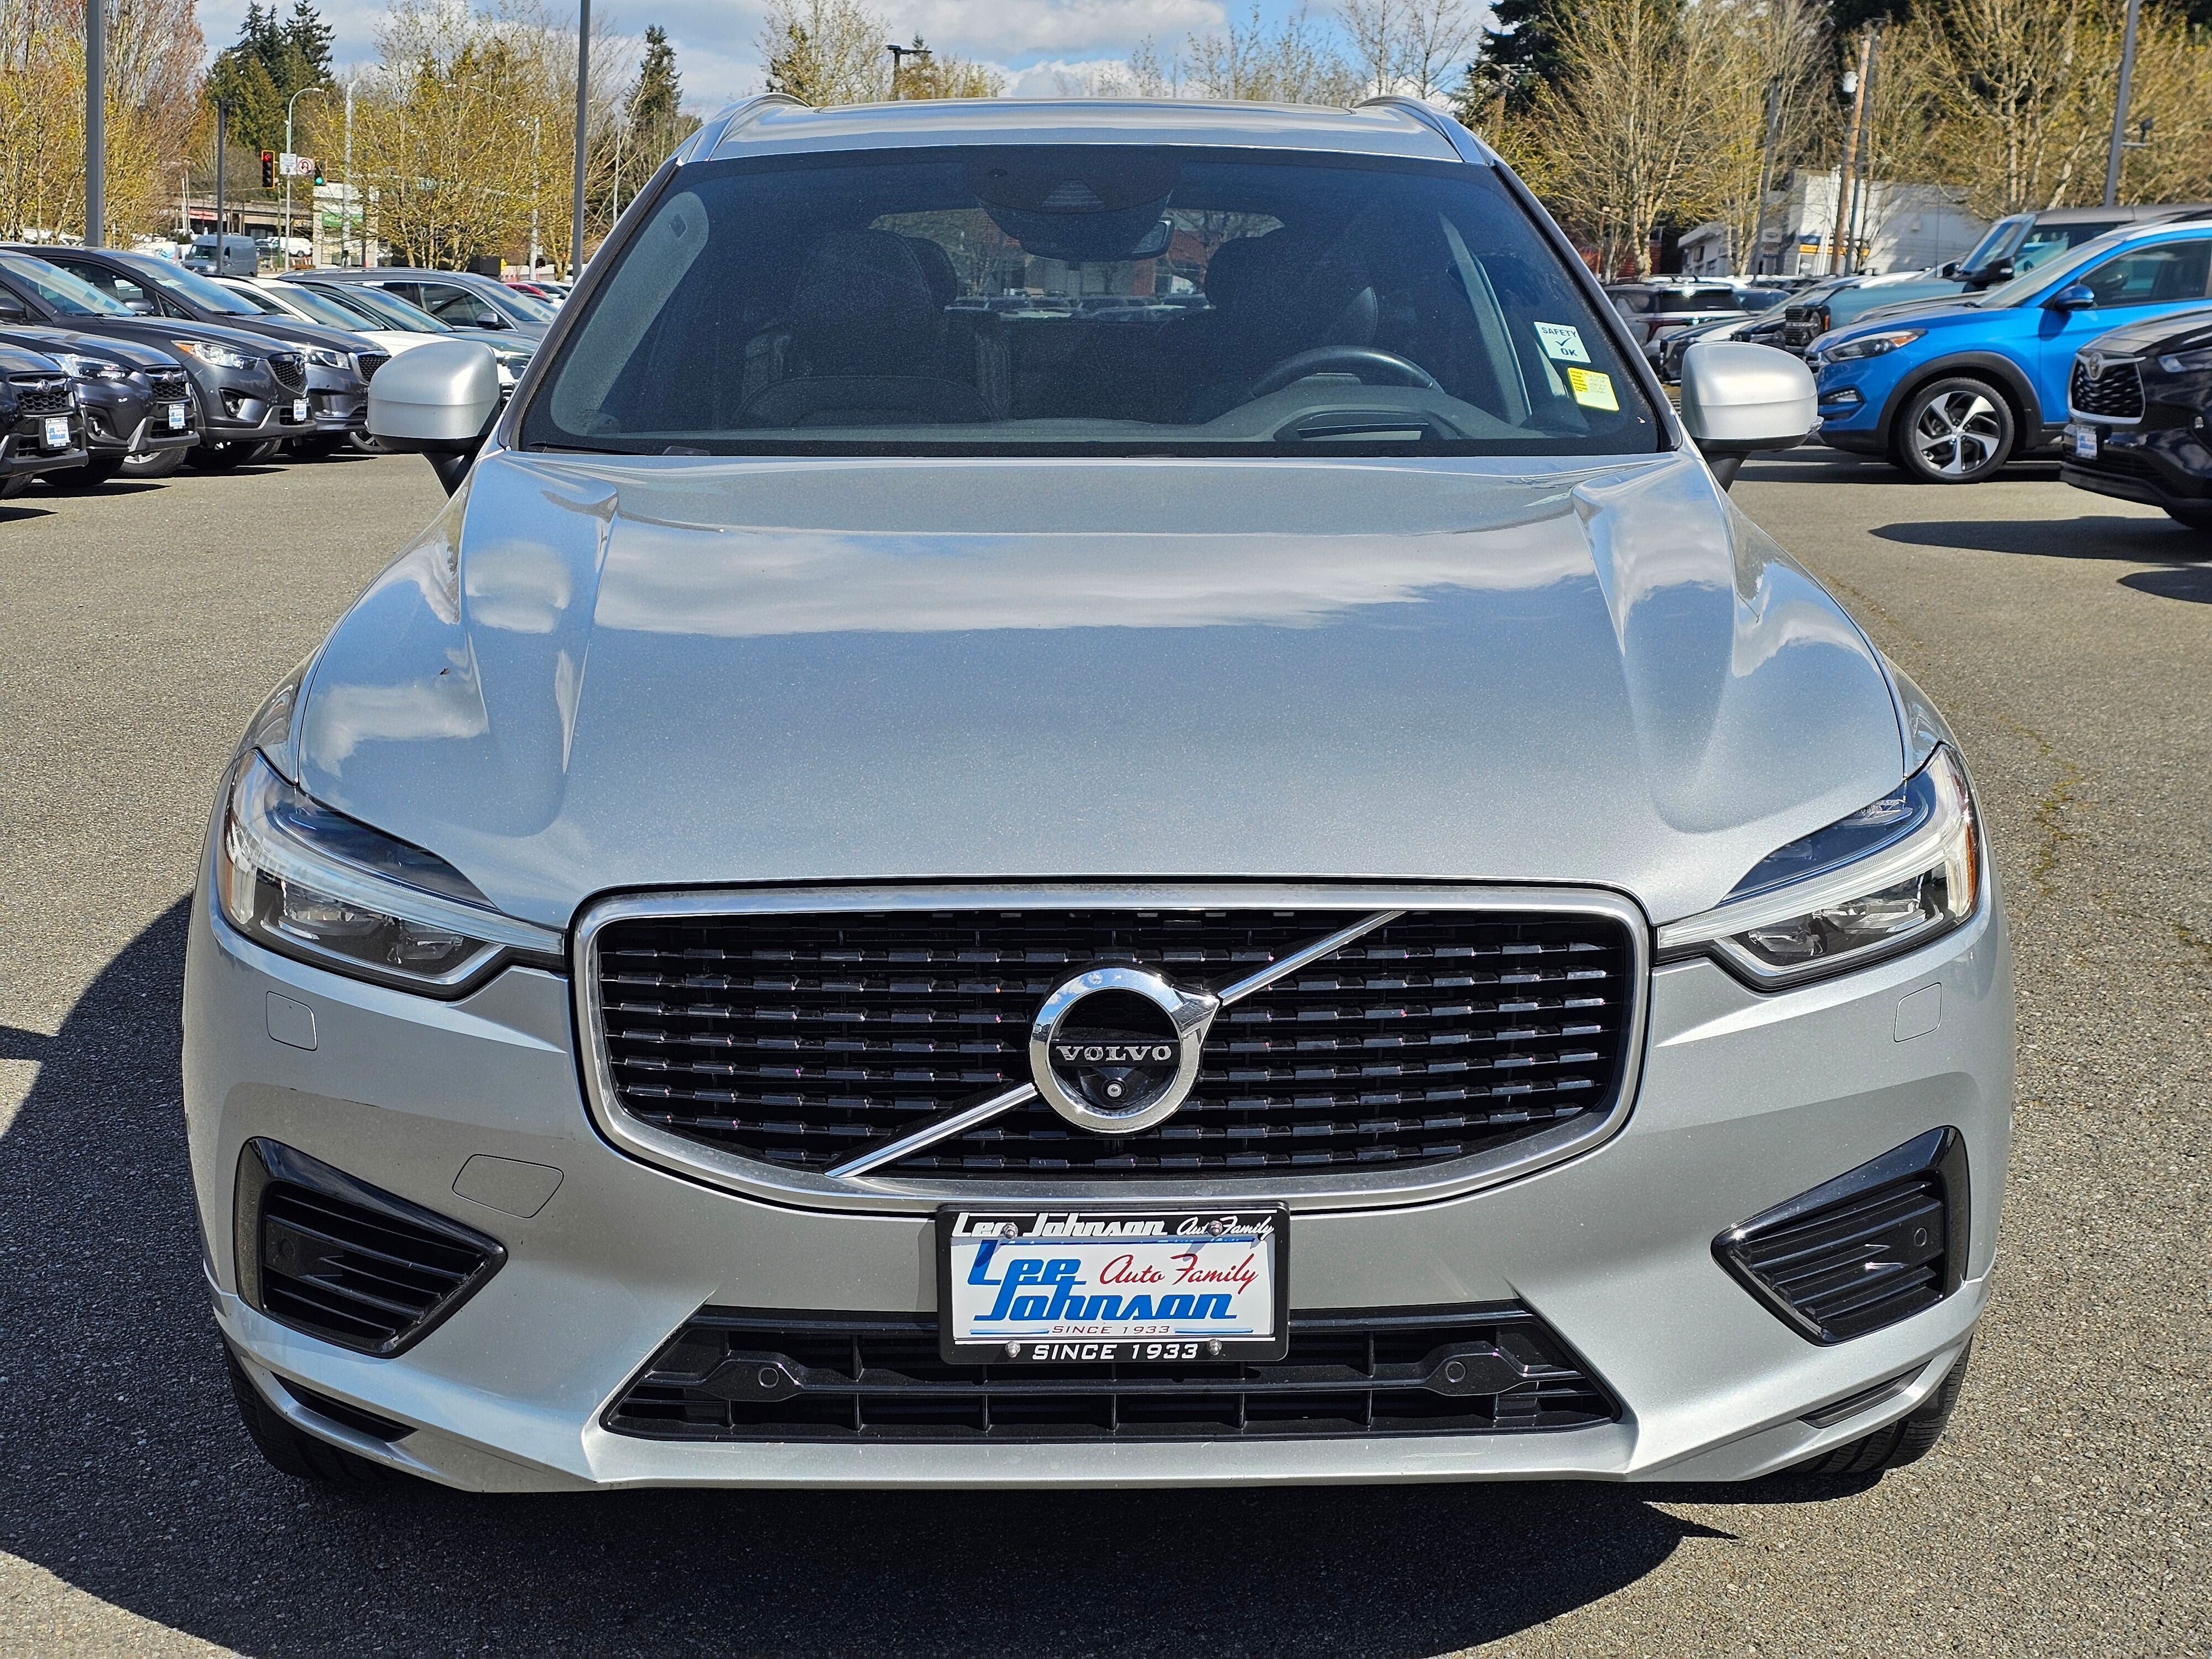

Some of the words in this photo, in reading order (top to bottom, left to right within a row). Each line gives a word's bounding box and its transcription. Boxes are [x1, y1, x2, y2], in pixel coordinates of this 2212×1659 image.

[1541, 327, 1577, 338] SAFETY
[1561, 348, 1578, 357] OK
[1056, 1046, 1171, 1061] VOLVO
[1022, 1213, 1167, 1237] Johnson
[1176, 1216, 1221, 1237] Aut
[1219, 1215, 1274, 1240] Family
[967, 1240, 1087, 1285] Lee
[1099, 1254, 1165, 1285] Auto
[1170, 1253, 1259, 1295] Family
[973, 1276, 1238, 1321] Johnson
[1052, 1326, 1113, 1334] SINCE
[1123, 1326, 1170, 1334] 1933
[1032, 1344, 1118, 1360] SINCE
[1131, 1343, 1198, 1359] 1933
